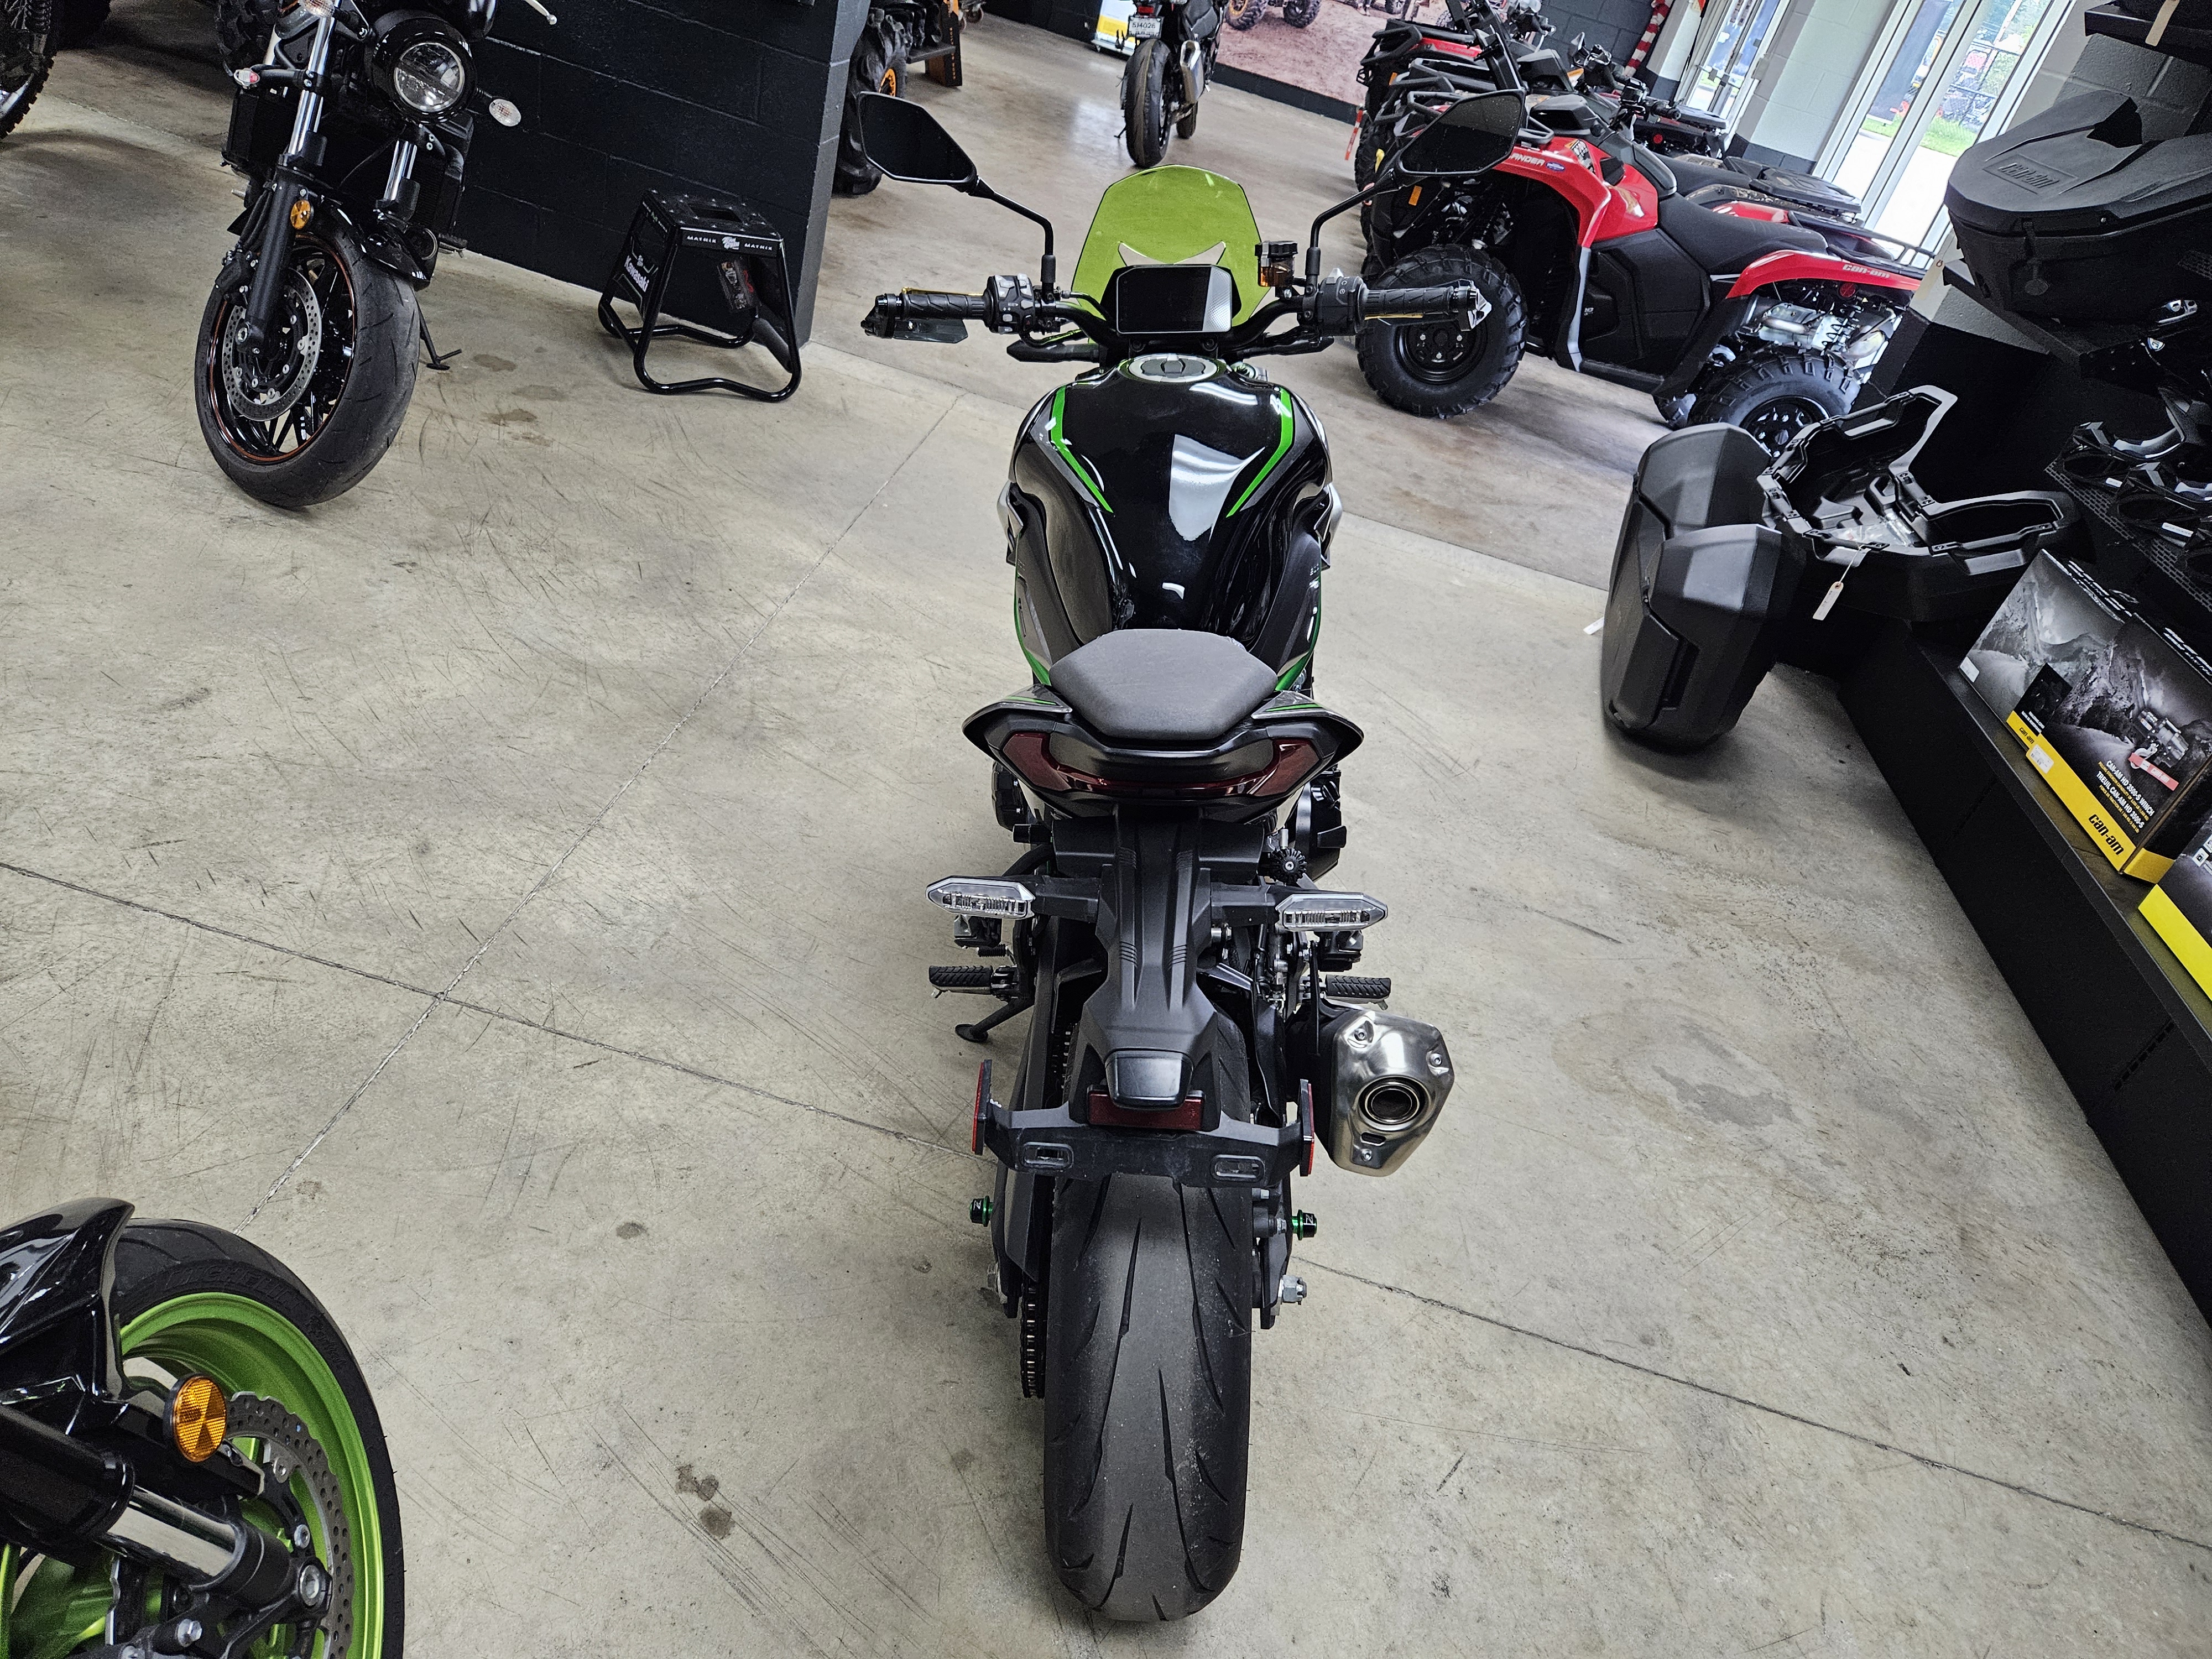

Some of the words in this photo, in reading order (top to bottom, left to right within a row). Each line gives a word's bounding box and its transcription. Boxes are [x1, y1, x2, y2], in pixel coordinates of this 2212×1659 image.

[1509, 153, 1546, 166] ANDER
[624, 255, 650, 293] Kawasaki
[2019, 727, 2034, 744] can-am
[2096, 770, 2111, 790] TREUIL
[2110, 786, 2127, 807] CAN-AM
[2124, 803, 2132, 813] HD
[2130, 811, 2145, 828] 3500-S
[2106, 760, 2124, 780] CAN-AM
[2120, 776, 2129, 786] HD
[2126, 784, 2142, 801] 3500-S
[2139, 797, 2155, 817] WINCH
[2089, 814, 2124, 855] can-am
